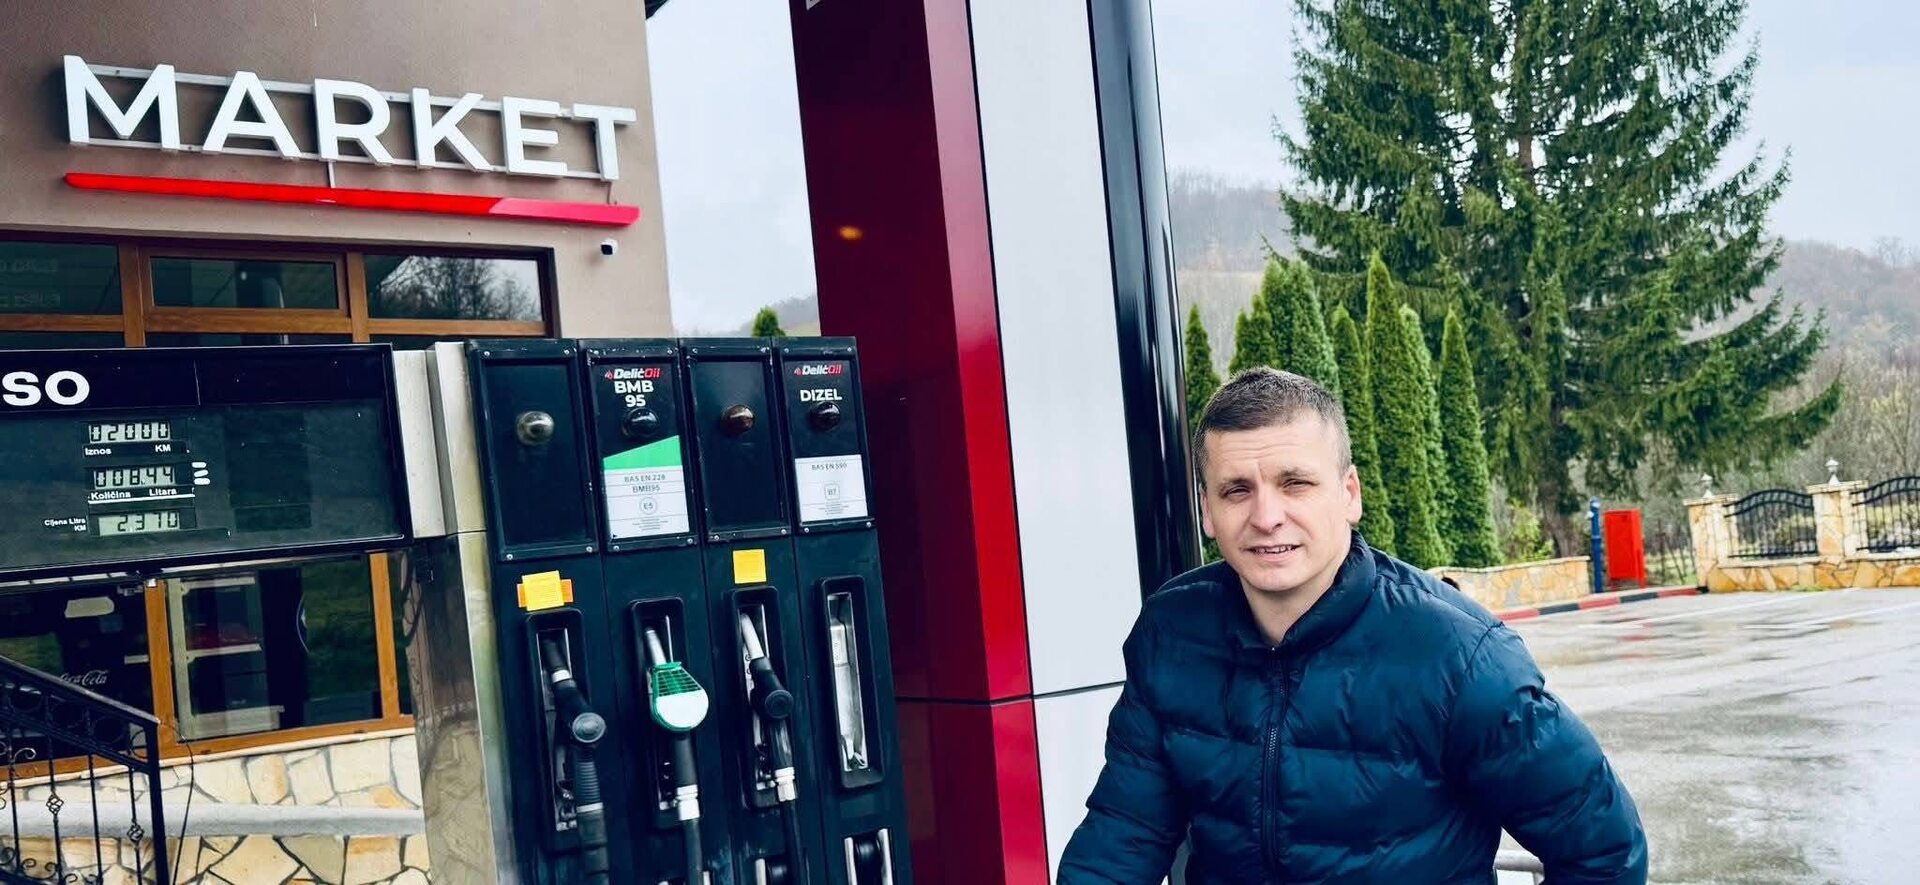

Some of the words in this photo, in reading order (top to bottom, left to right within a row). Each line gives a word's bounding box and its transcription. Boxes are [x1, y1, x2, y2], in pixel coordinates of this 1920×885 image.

[64, 54, 636, 181] MARKET
[2, 370, 90, 406] SO
[614, 380, 654, 394] BMB
[625, 394, 646, 408] 95
[800, 388, 843, 402] DIZEL
[85, 447, 112, 456] Iznos
[155, 444, 171, 453] KM
[91, 490, 132, 500] Količina
[149, 488, 177, 496] Litara
[44, 519, 68, 527] Cijena
